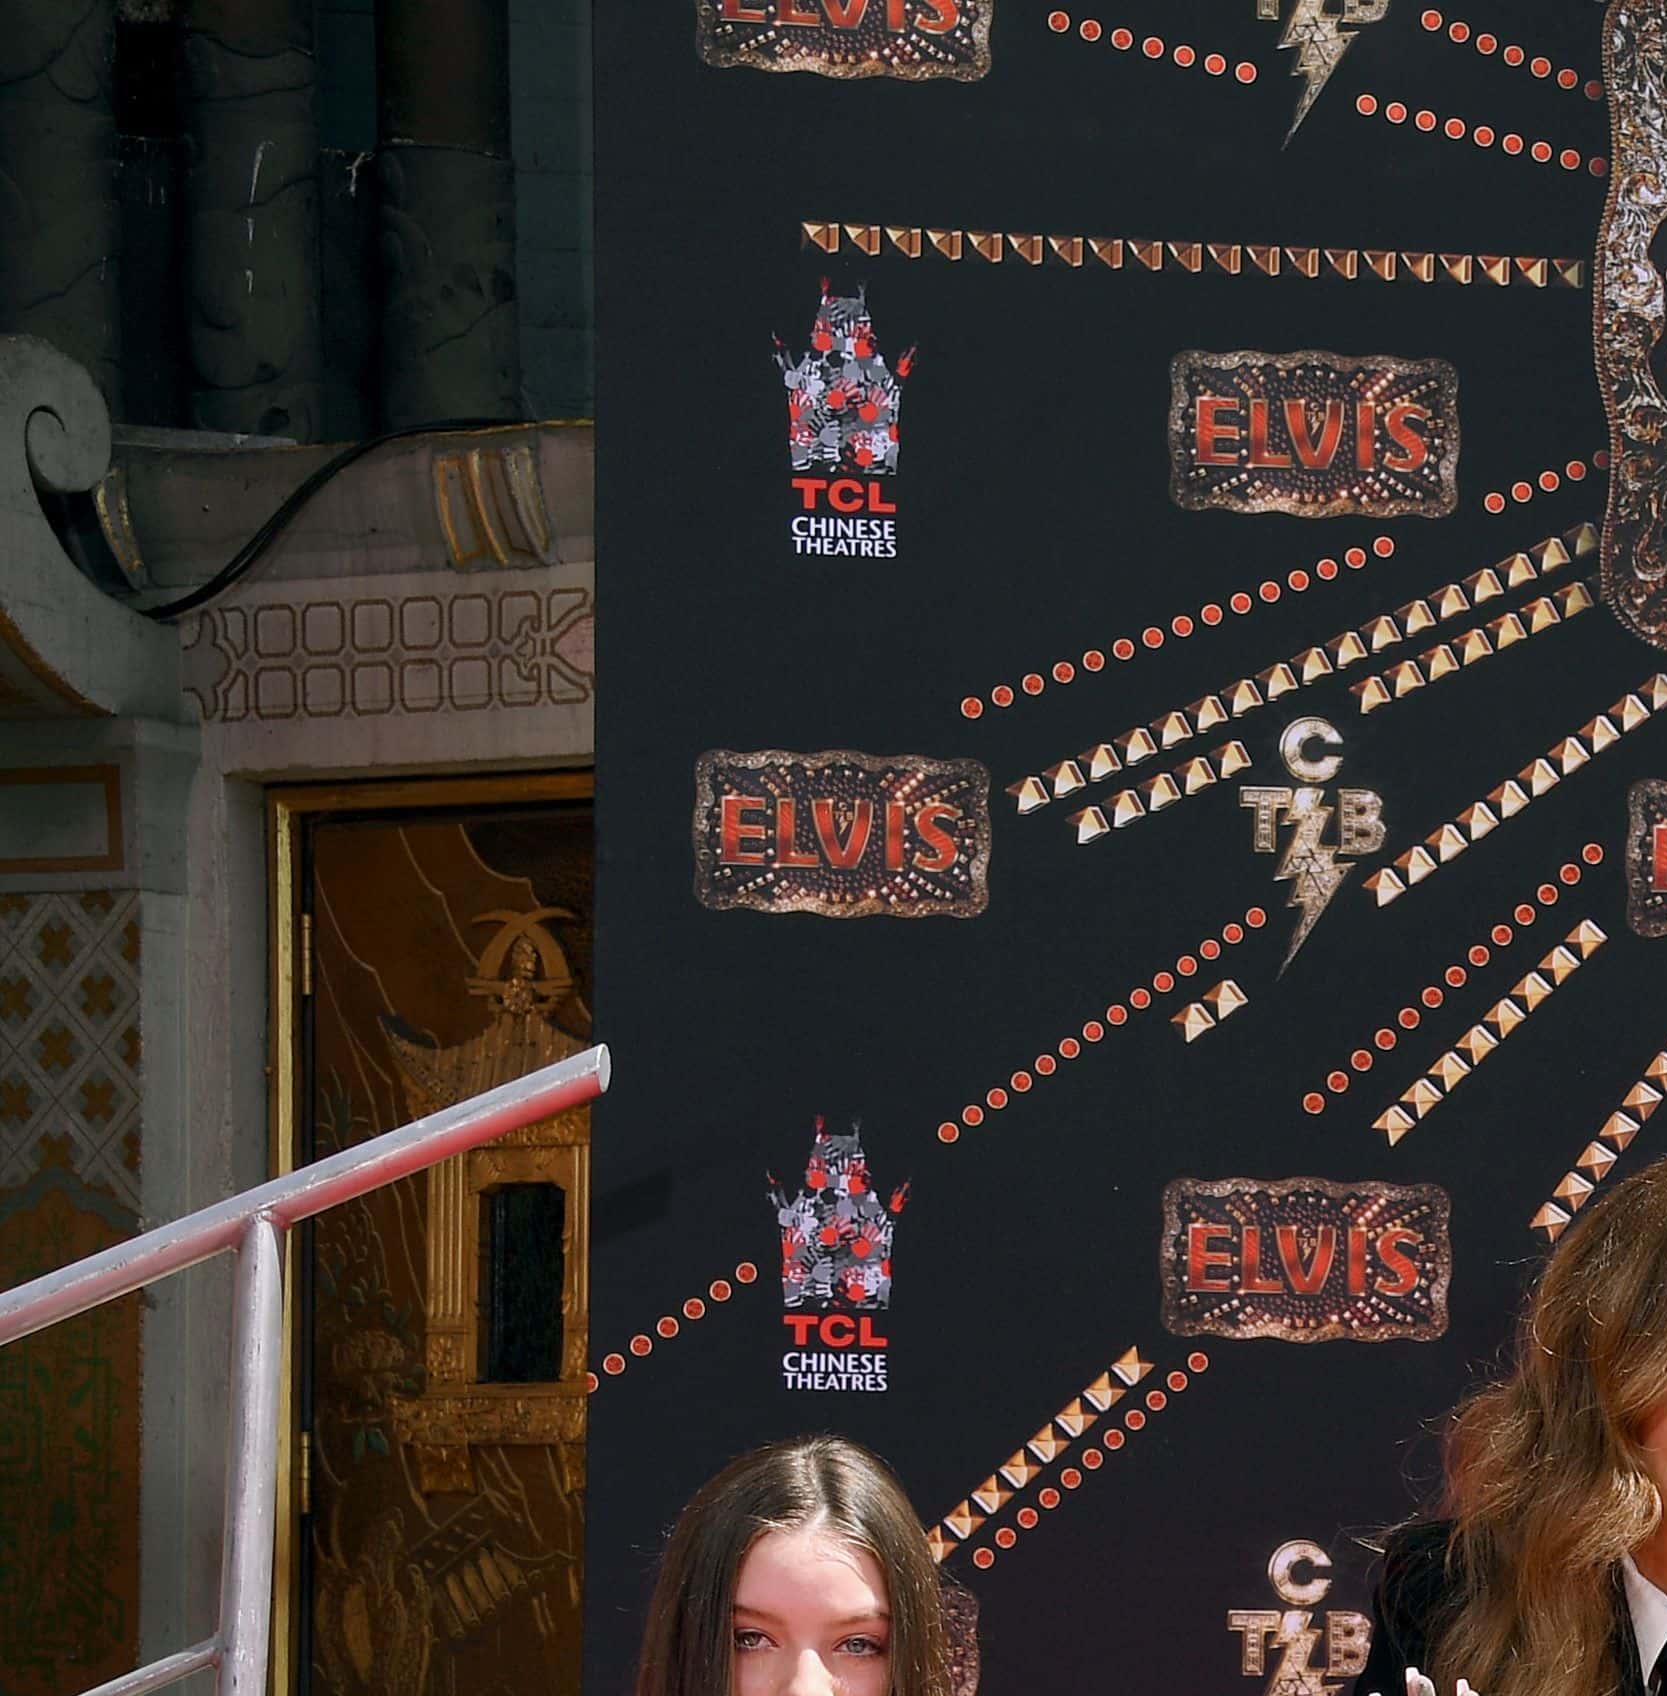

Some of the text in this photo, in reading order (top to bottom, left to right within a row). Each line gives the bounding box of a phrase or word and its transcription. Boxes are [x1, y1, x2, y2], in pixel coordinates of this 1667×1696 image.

[1194, 395, 1432, 472] ELVIS
[792, 479, 896, 513] TCL
[791, 517, 895, 541] CHINESE
[792, 539, 897, 558] THEATRES
[718, 795, 961, 873] ELVIS
[1185, 1223, 1424, 1298] ELVIS
[784, 1315, 888, 1348] TCL
[782, 1352, 887, 1374] CHINESE
[783, 1373, 888, 1392] THEATRES
